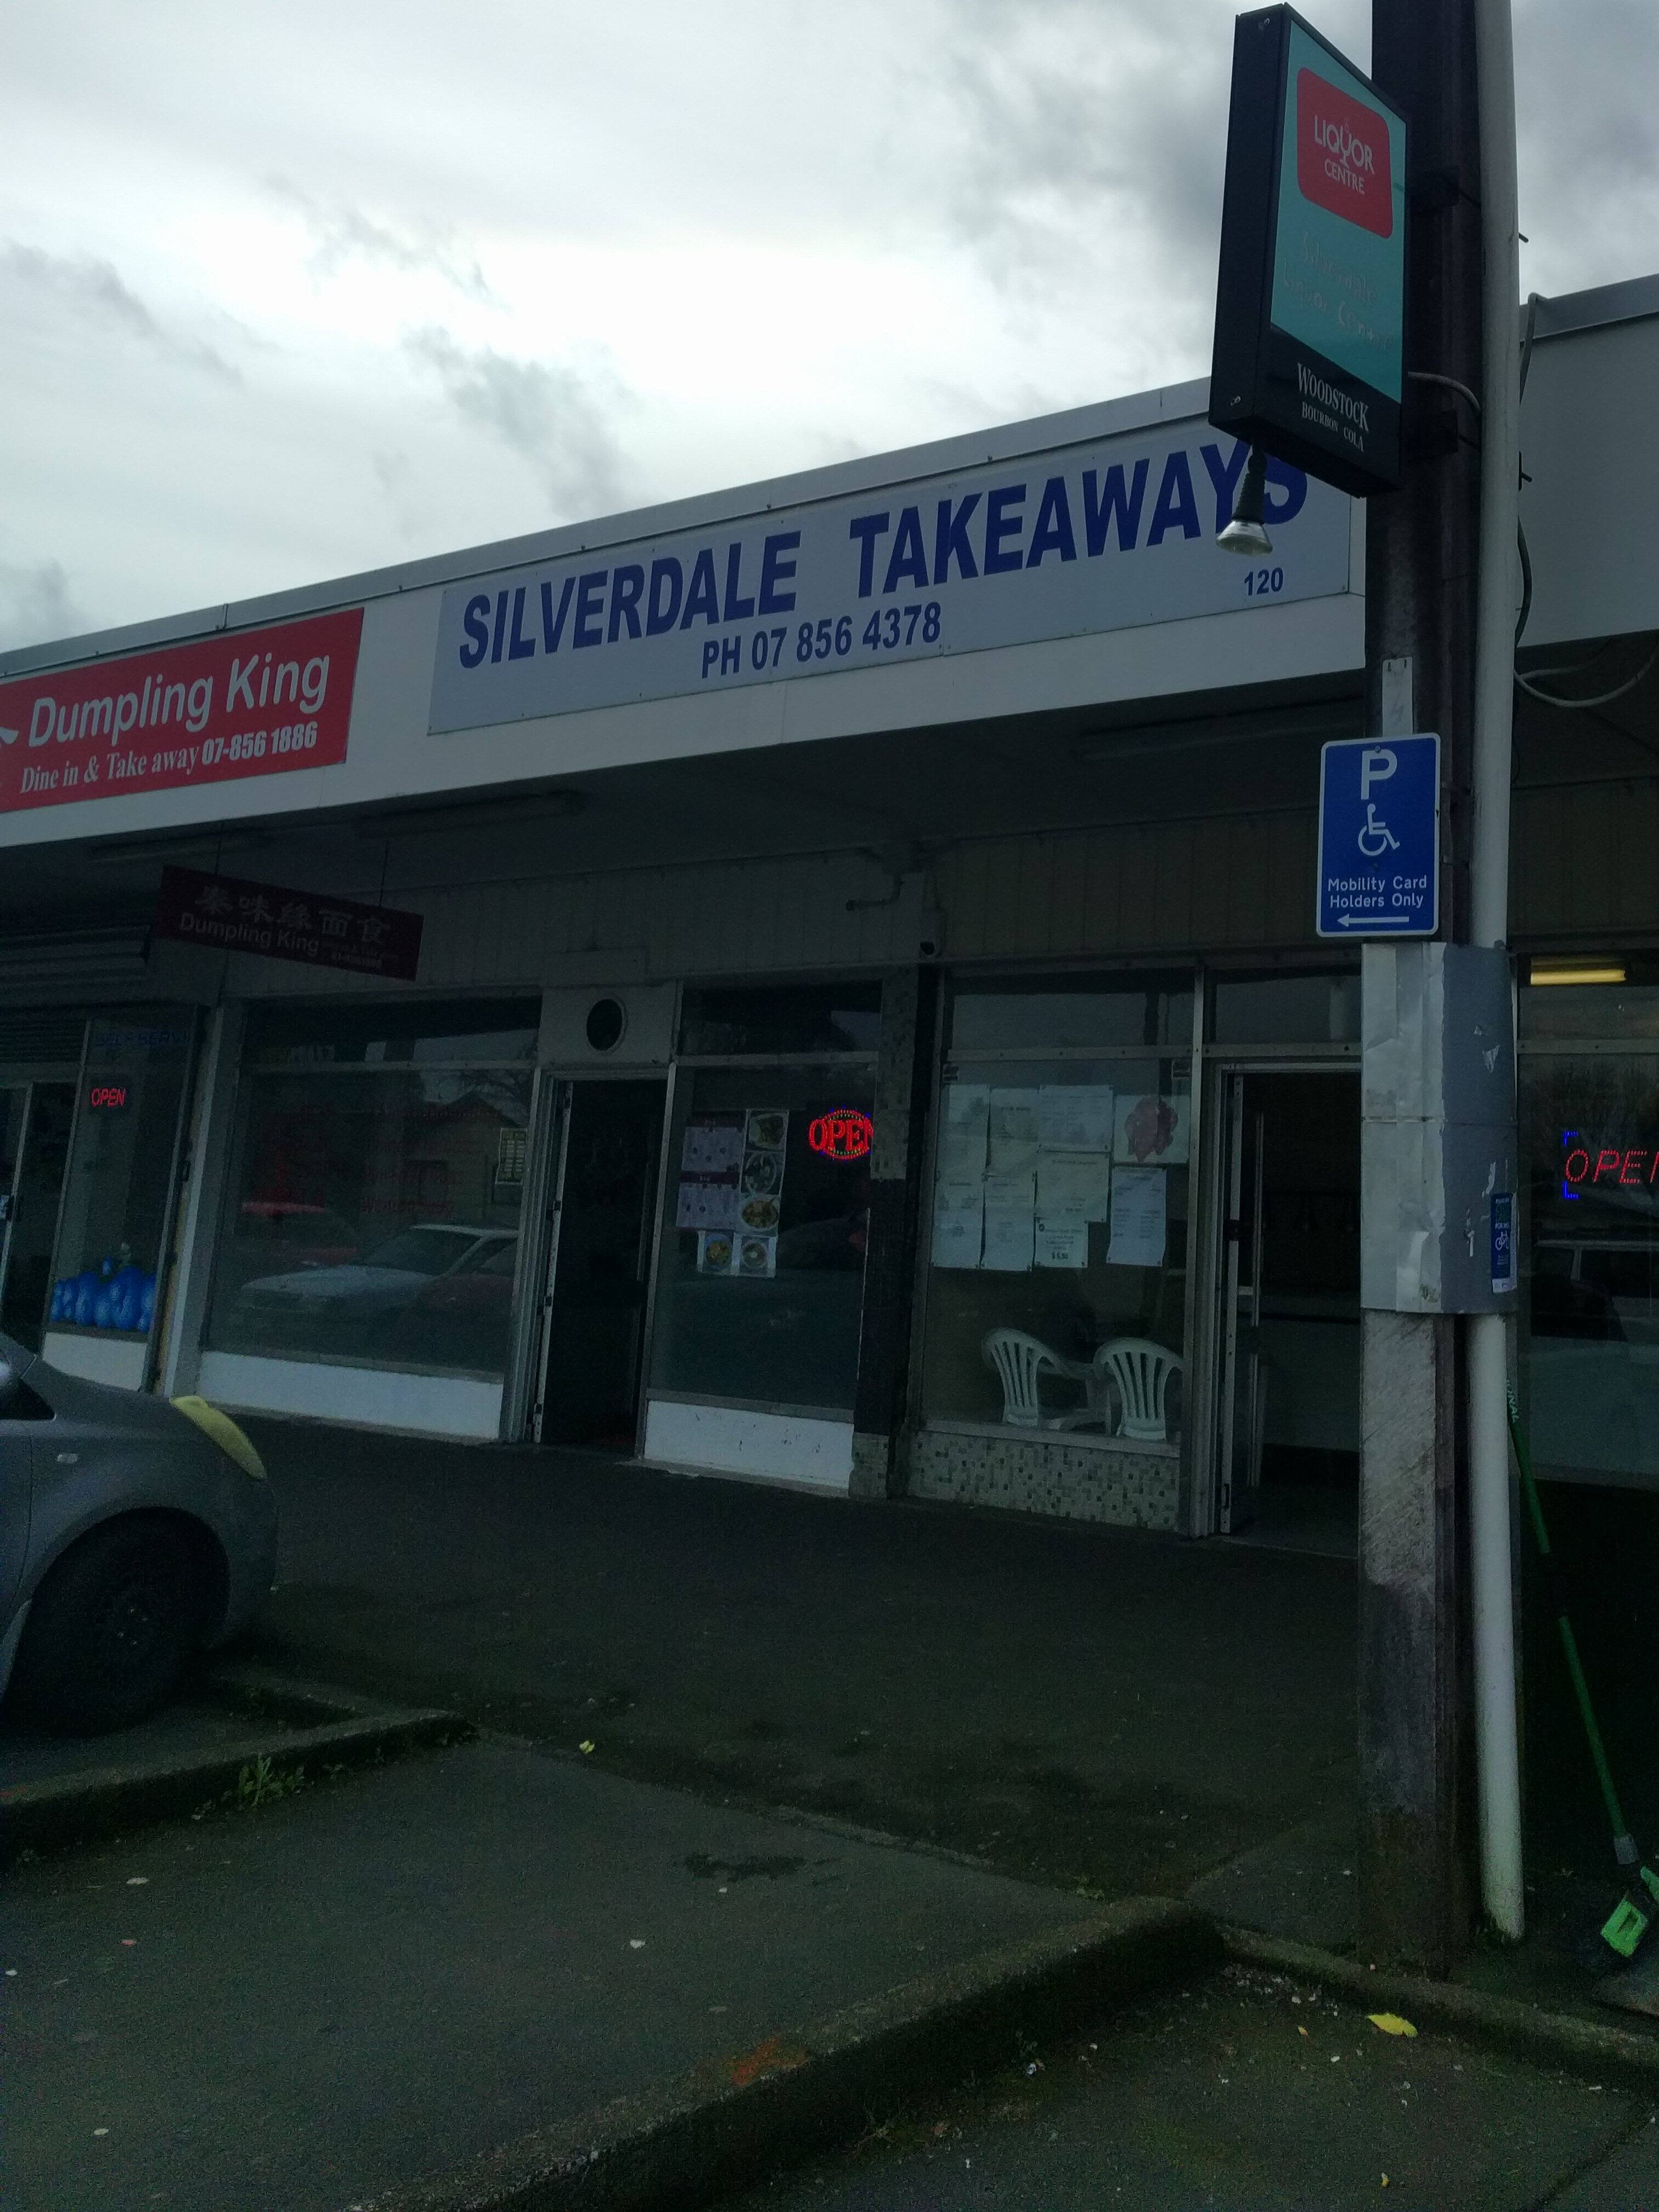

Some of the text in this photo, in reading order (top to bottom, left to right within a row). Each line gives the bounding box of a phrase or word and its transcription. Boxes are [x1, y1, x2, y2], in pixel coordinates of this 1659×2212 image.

[1314, 114, 1375, 175] LIQUOR
[1324, 159, 1365, 195] CENTRE
[1296, 362, 1369, 432] WOODSTOCK
[1301, 401, 1364, 453] BOURBON COLA
[460, 531, 801, 668] SILVERDALE
[1244, 567, 1283, 596] 120
[702, 602, 941, 679] PH 07 856 4378
[29, 652, 330, 747] Dumpling King
[20, 721, 318, 794] Dine in & Take away 07-856 1886
[1361, 749, 1397, 800] P
[1328, 875, 1427, 893] Mobility Card
[1330, 893, 1424, 909] Holders Only
[179, 911, 273, 950] Dumpling
[277, 932, 319, 957] King
[90, 1087, 126, 1107] OPEN
